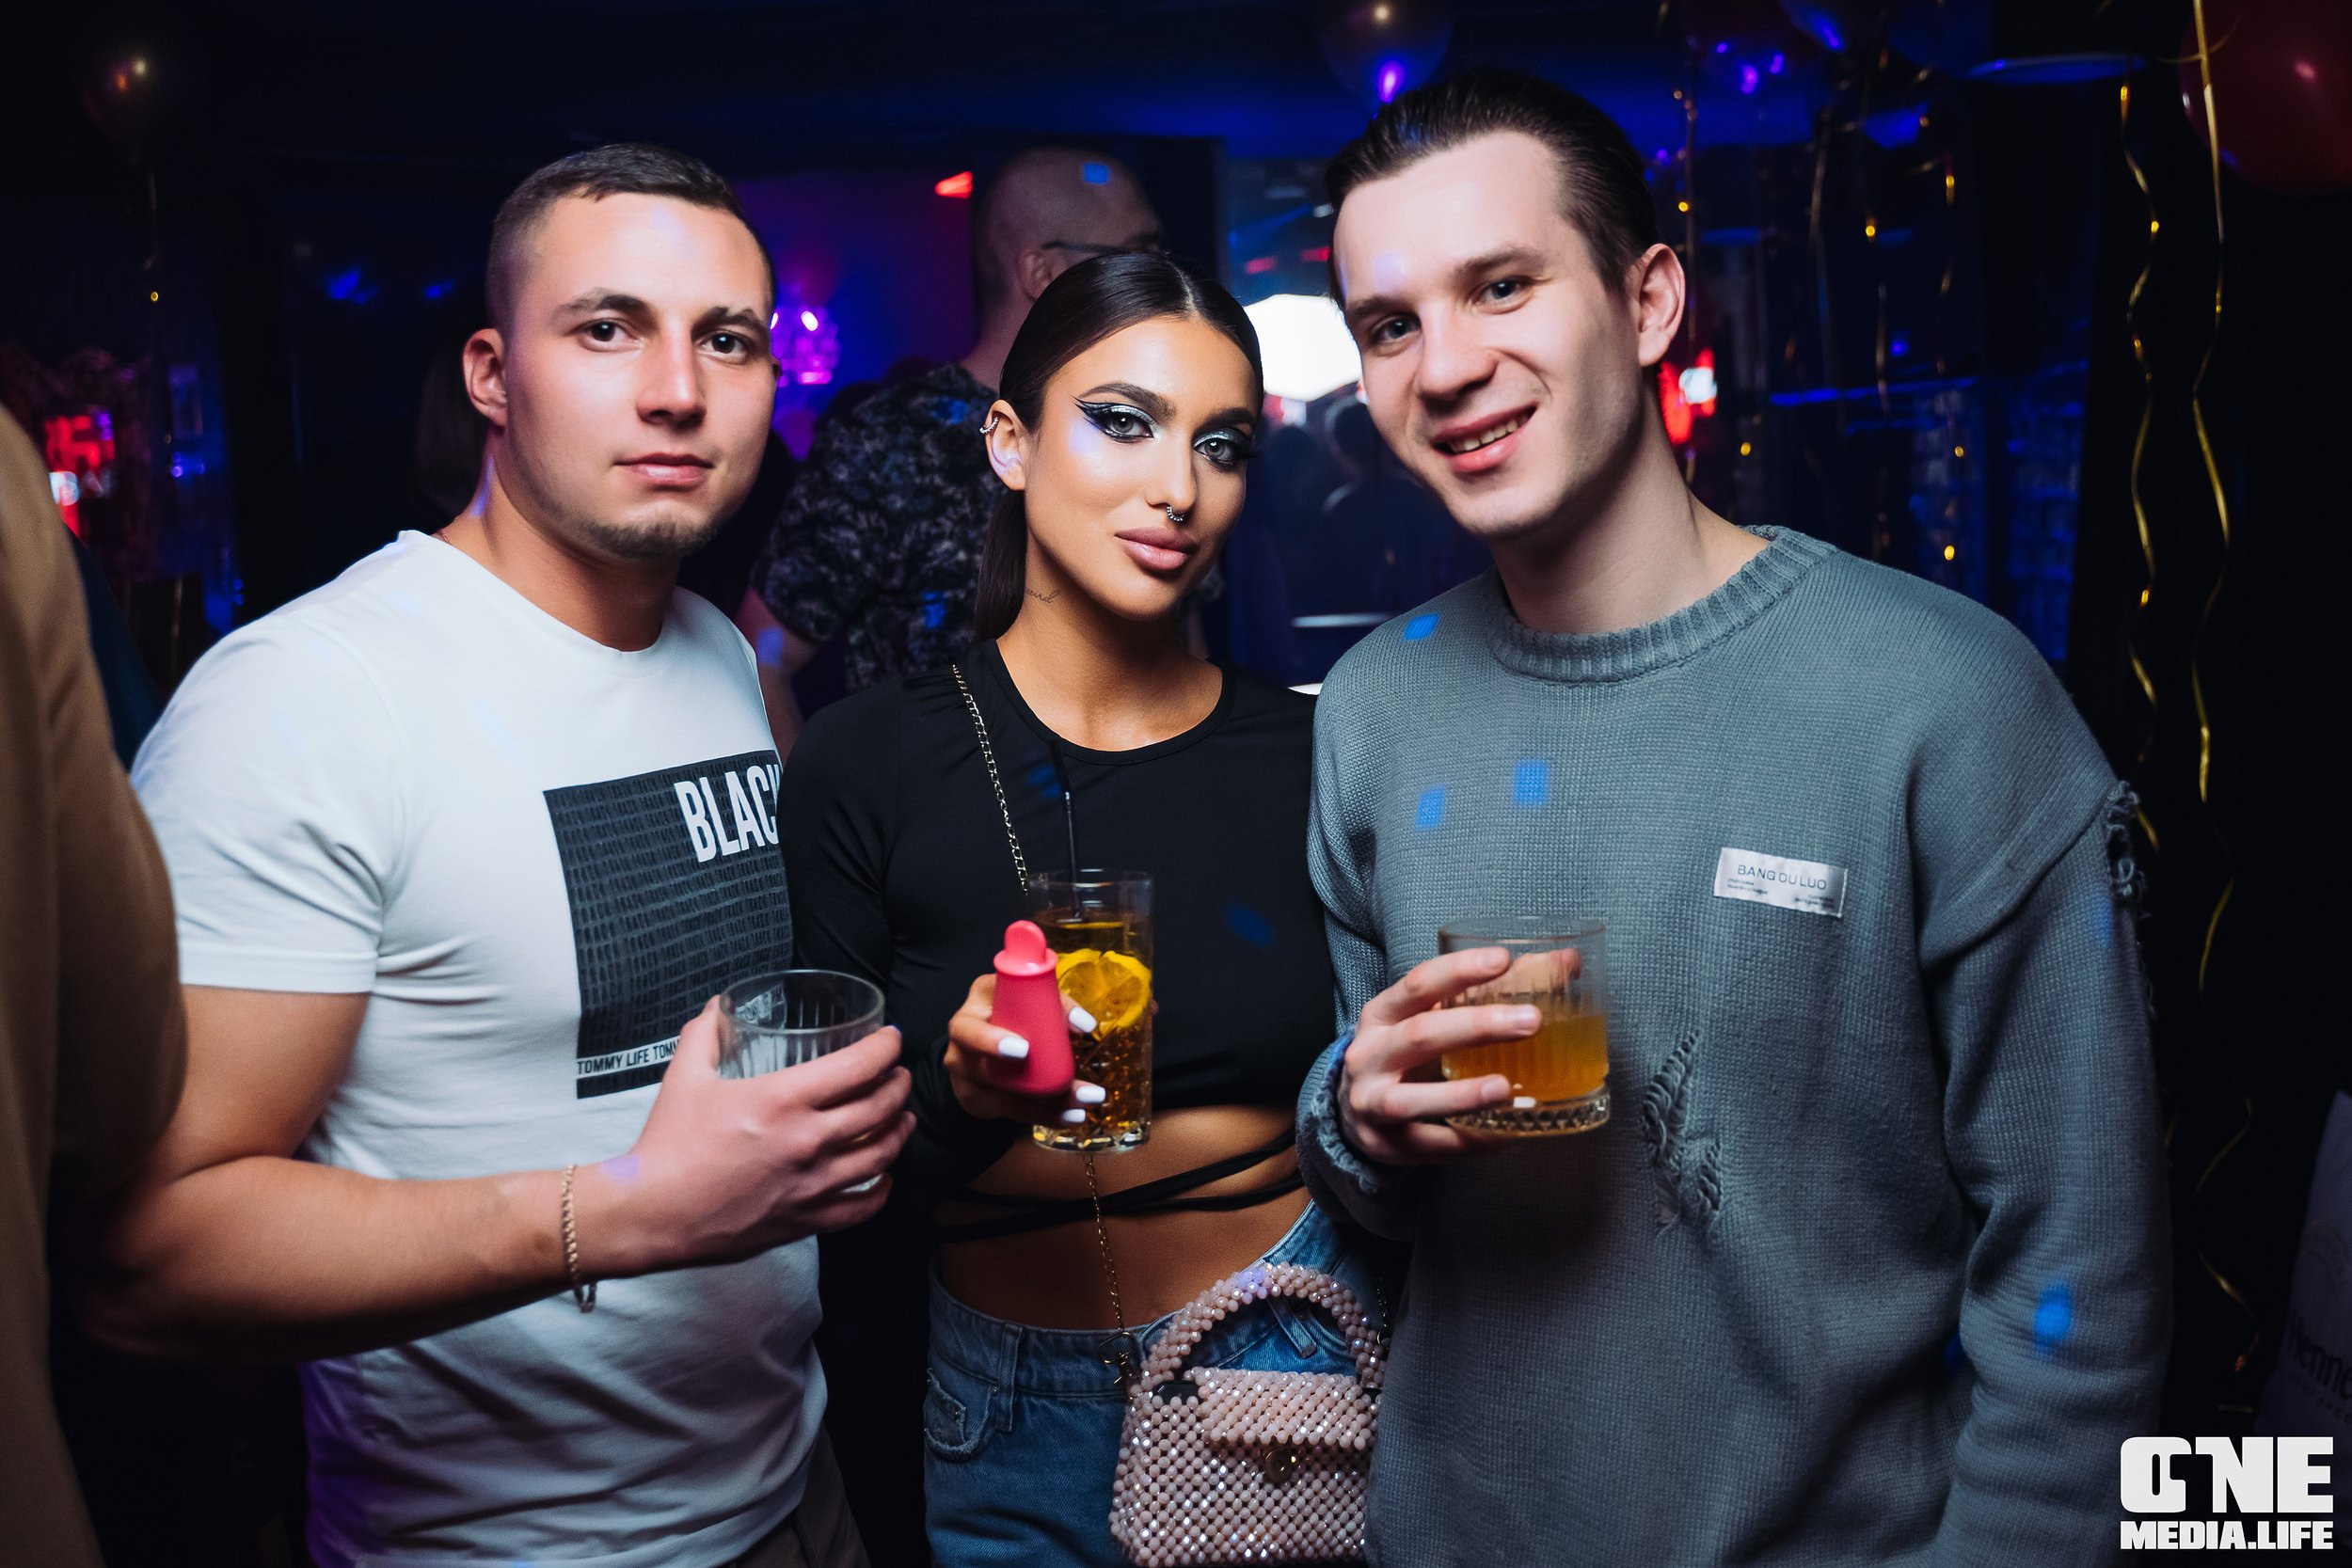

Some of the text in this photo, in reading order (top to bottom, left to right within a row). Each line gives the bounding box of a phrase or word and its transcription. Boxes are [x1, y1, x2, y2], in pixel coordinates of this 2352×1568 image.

[1738, 864, 1775, 880] BANG
[577, 1054, 623, 1074] TOMMY
[627, 1049, 649, 1066] LIFE
